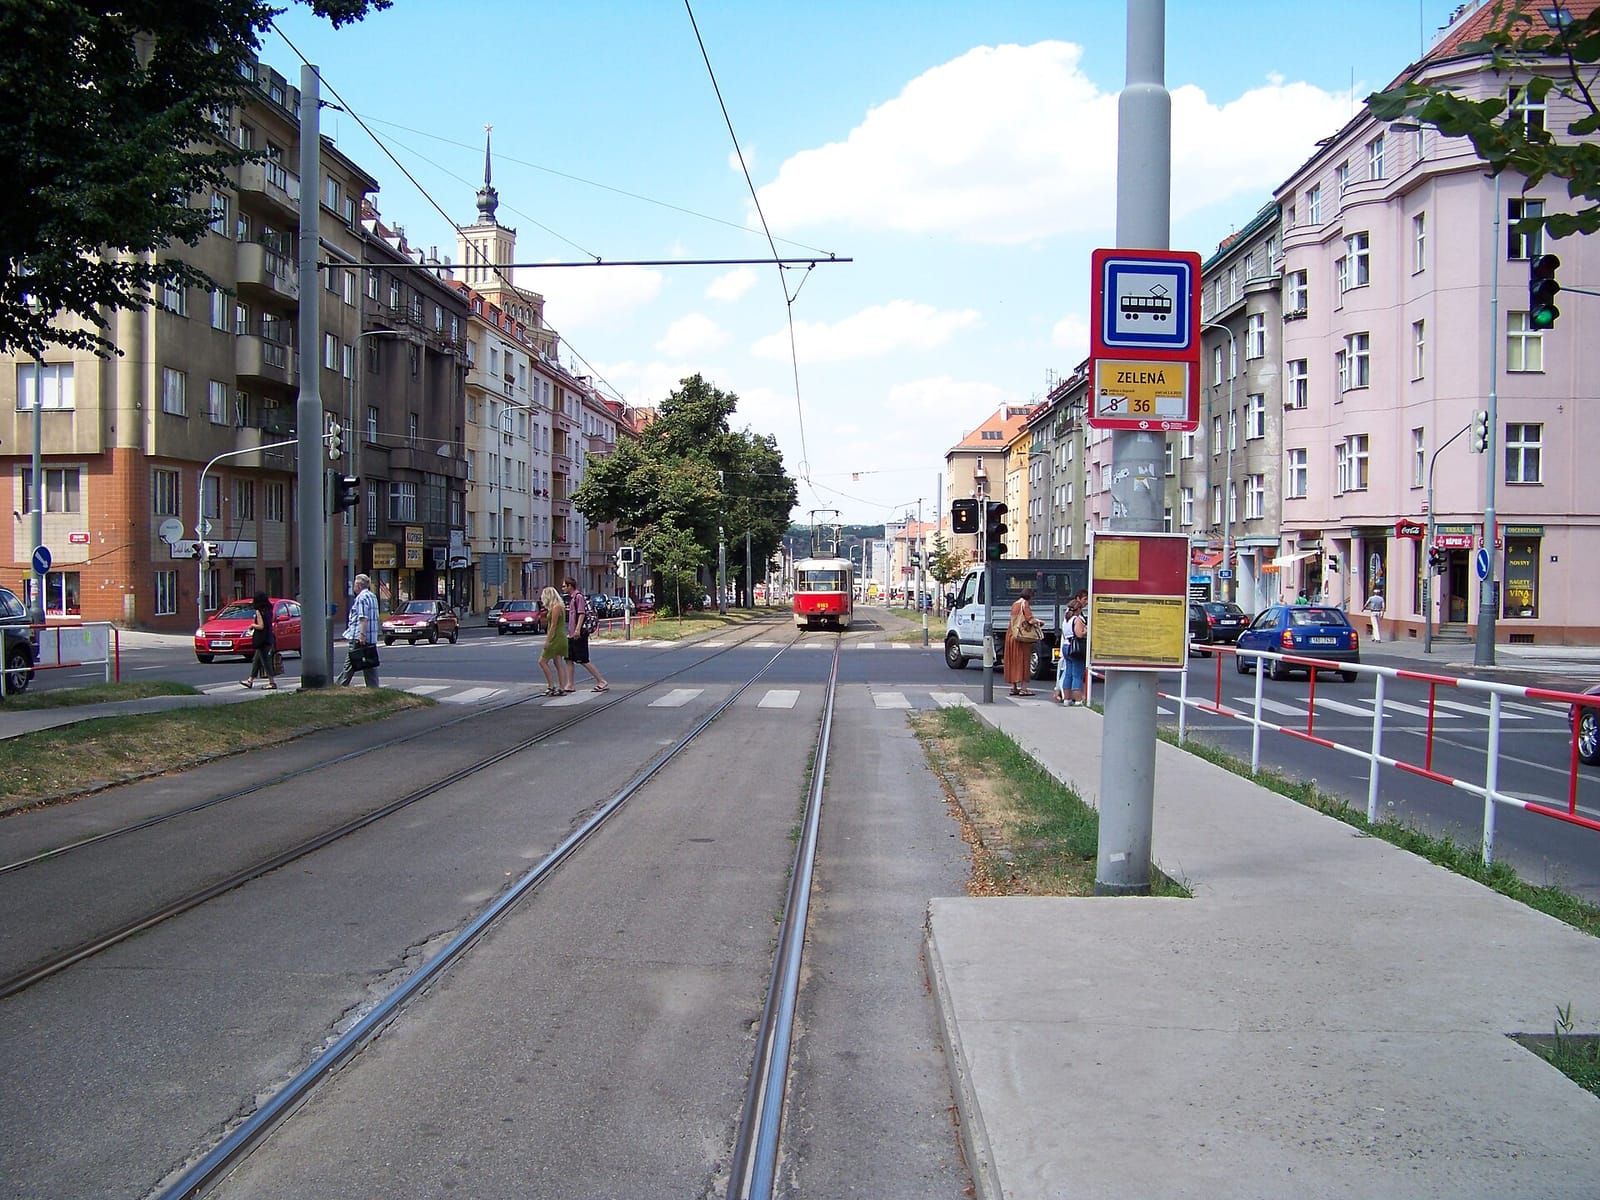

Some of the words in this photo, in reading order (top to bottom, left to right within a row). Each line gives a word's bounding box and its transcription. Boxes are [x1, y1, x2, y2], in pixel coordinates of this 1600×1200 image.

[1117, 370, 1165, 384] ZELENÁ
[1110, 398, 1118, 411] 8
[1133, 399, 1150, 412] 36
